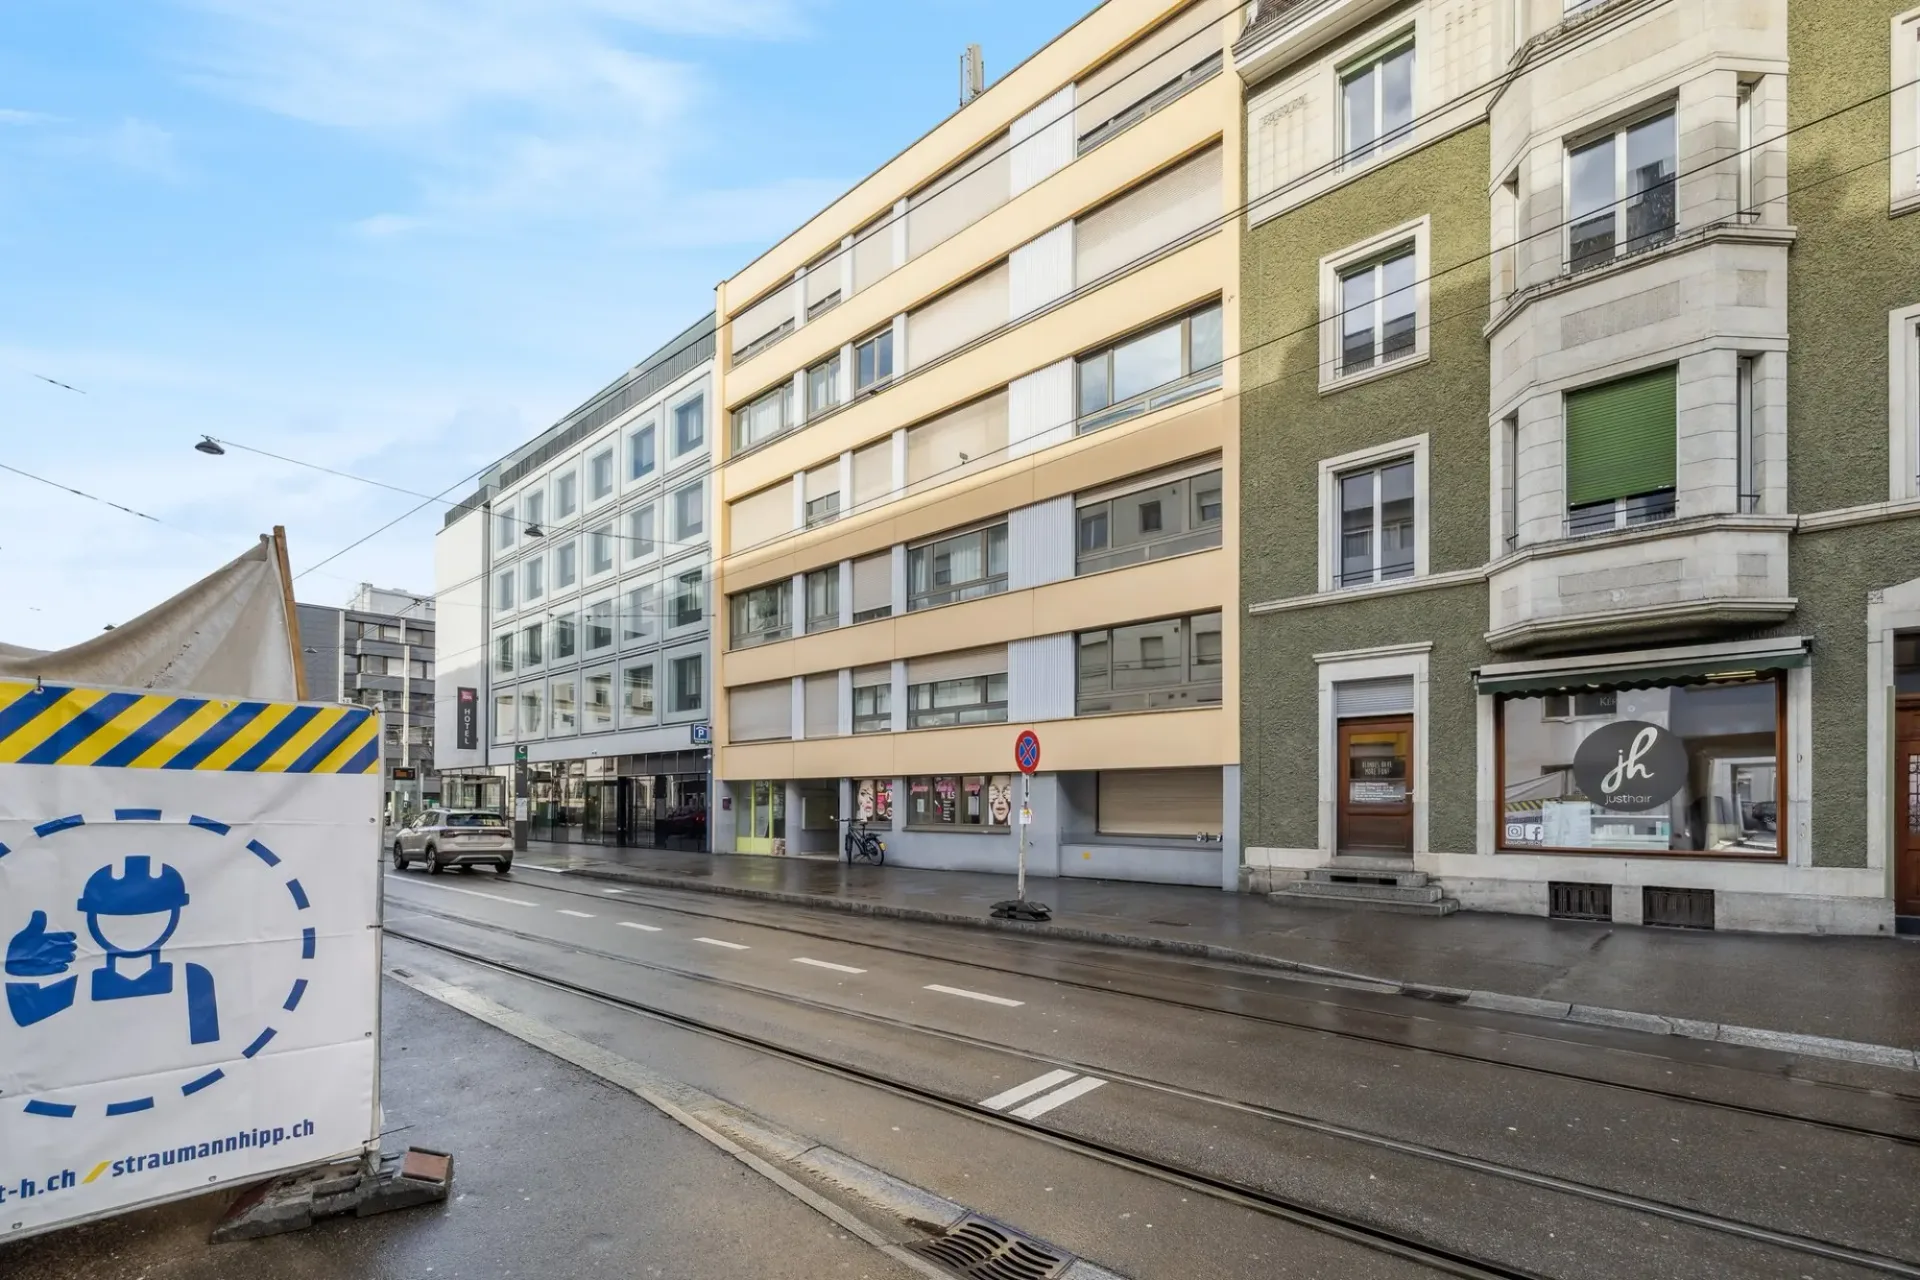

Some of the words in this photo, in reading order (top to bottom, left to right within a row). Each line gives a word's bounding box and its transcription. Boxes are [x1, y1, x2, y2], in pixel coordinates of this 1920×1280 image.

[1600, 726, 1658, 794] jh
[1604, 794, 1653, 806] justhair
[112, 1118, 315, 1178] straumannhipp.ch
